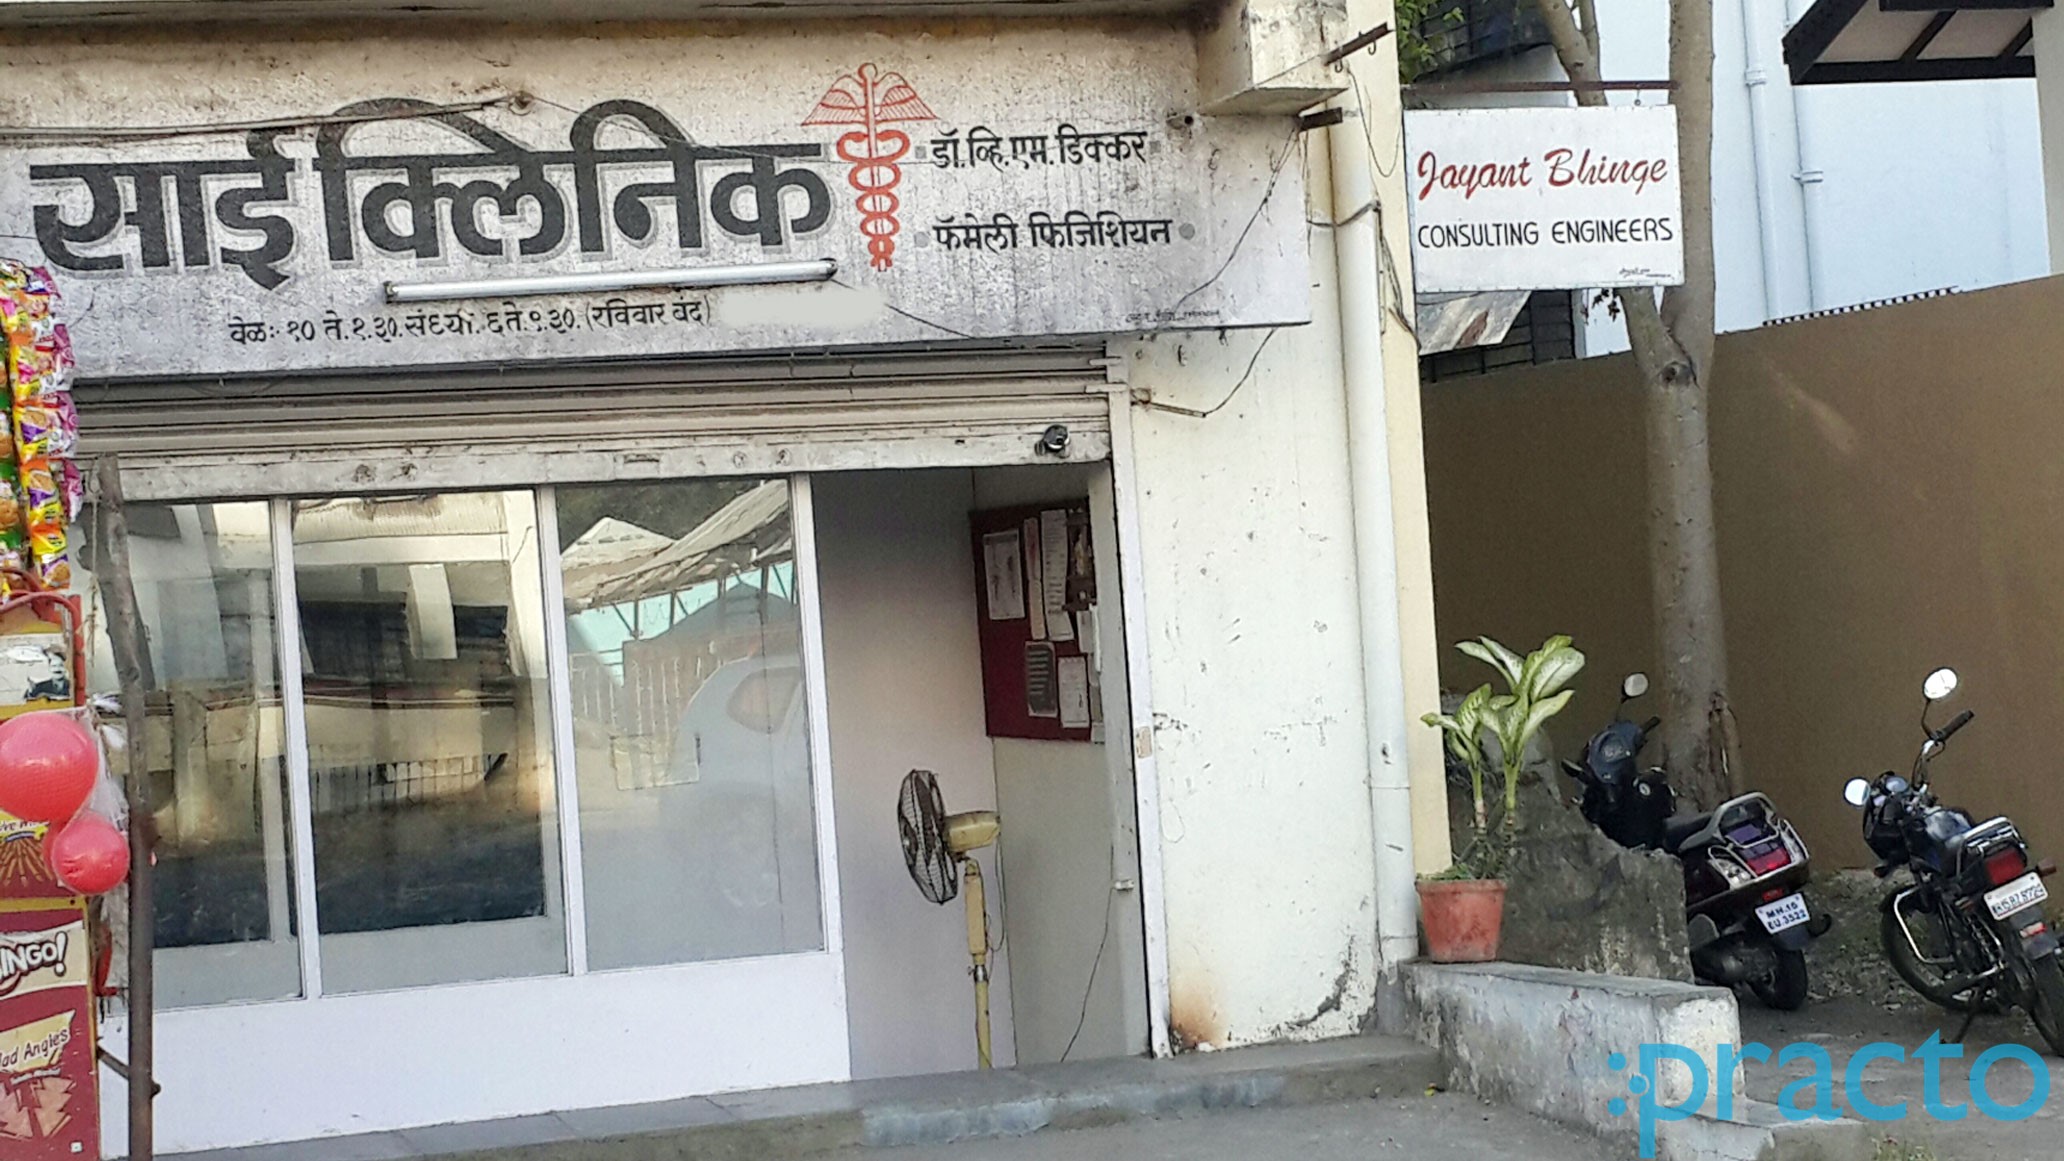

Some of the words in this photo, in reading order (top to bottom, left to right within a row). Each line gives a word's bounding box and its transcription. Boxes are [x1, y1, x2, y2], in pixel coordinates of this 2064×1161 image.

[30, 125, 296, 291] साई
[311, 97, 834, 264] क्लिनिक
[1417, 151, 1533, 200] Jayant
[1544, 148, 1668, 195] Bhinge
[1028, 210, 1173, 248] फिजिशियन
[1418, 221, 1539, 248] CONSULTING
[1551, 218, 1673, 244] ENGINEERS
[0, 931, 68, 979] INGO!
[24, 1028, 69, 1060] Angles
